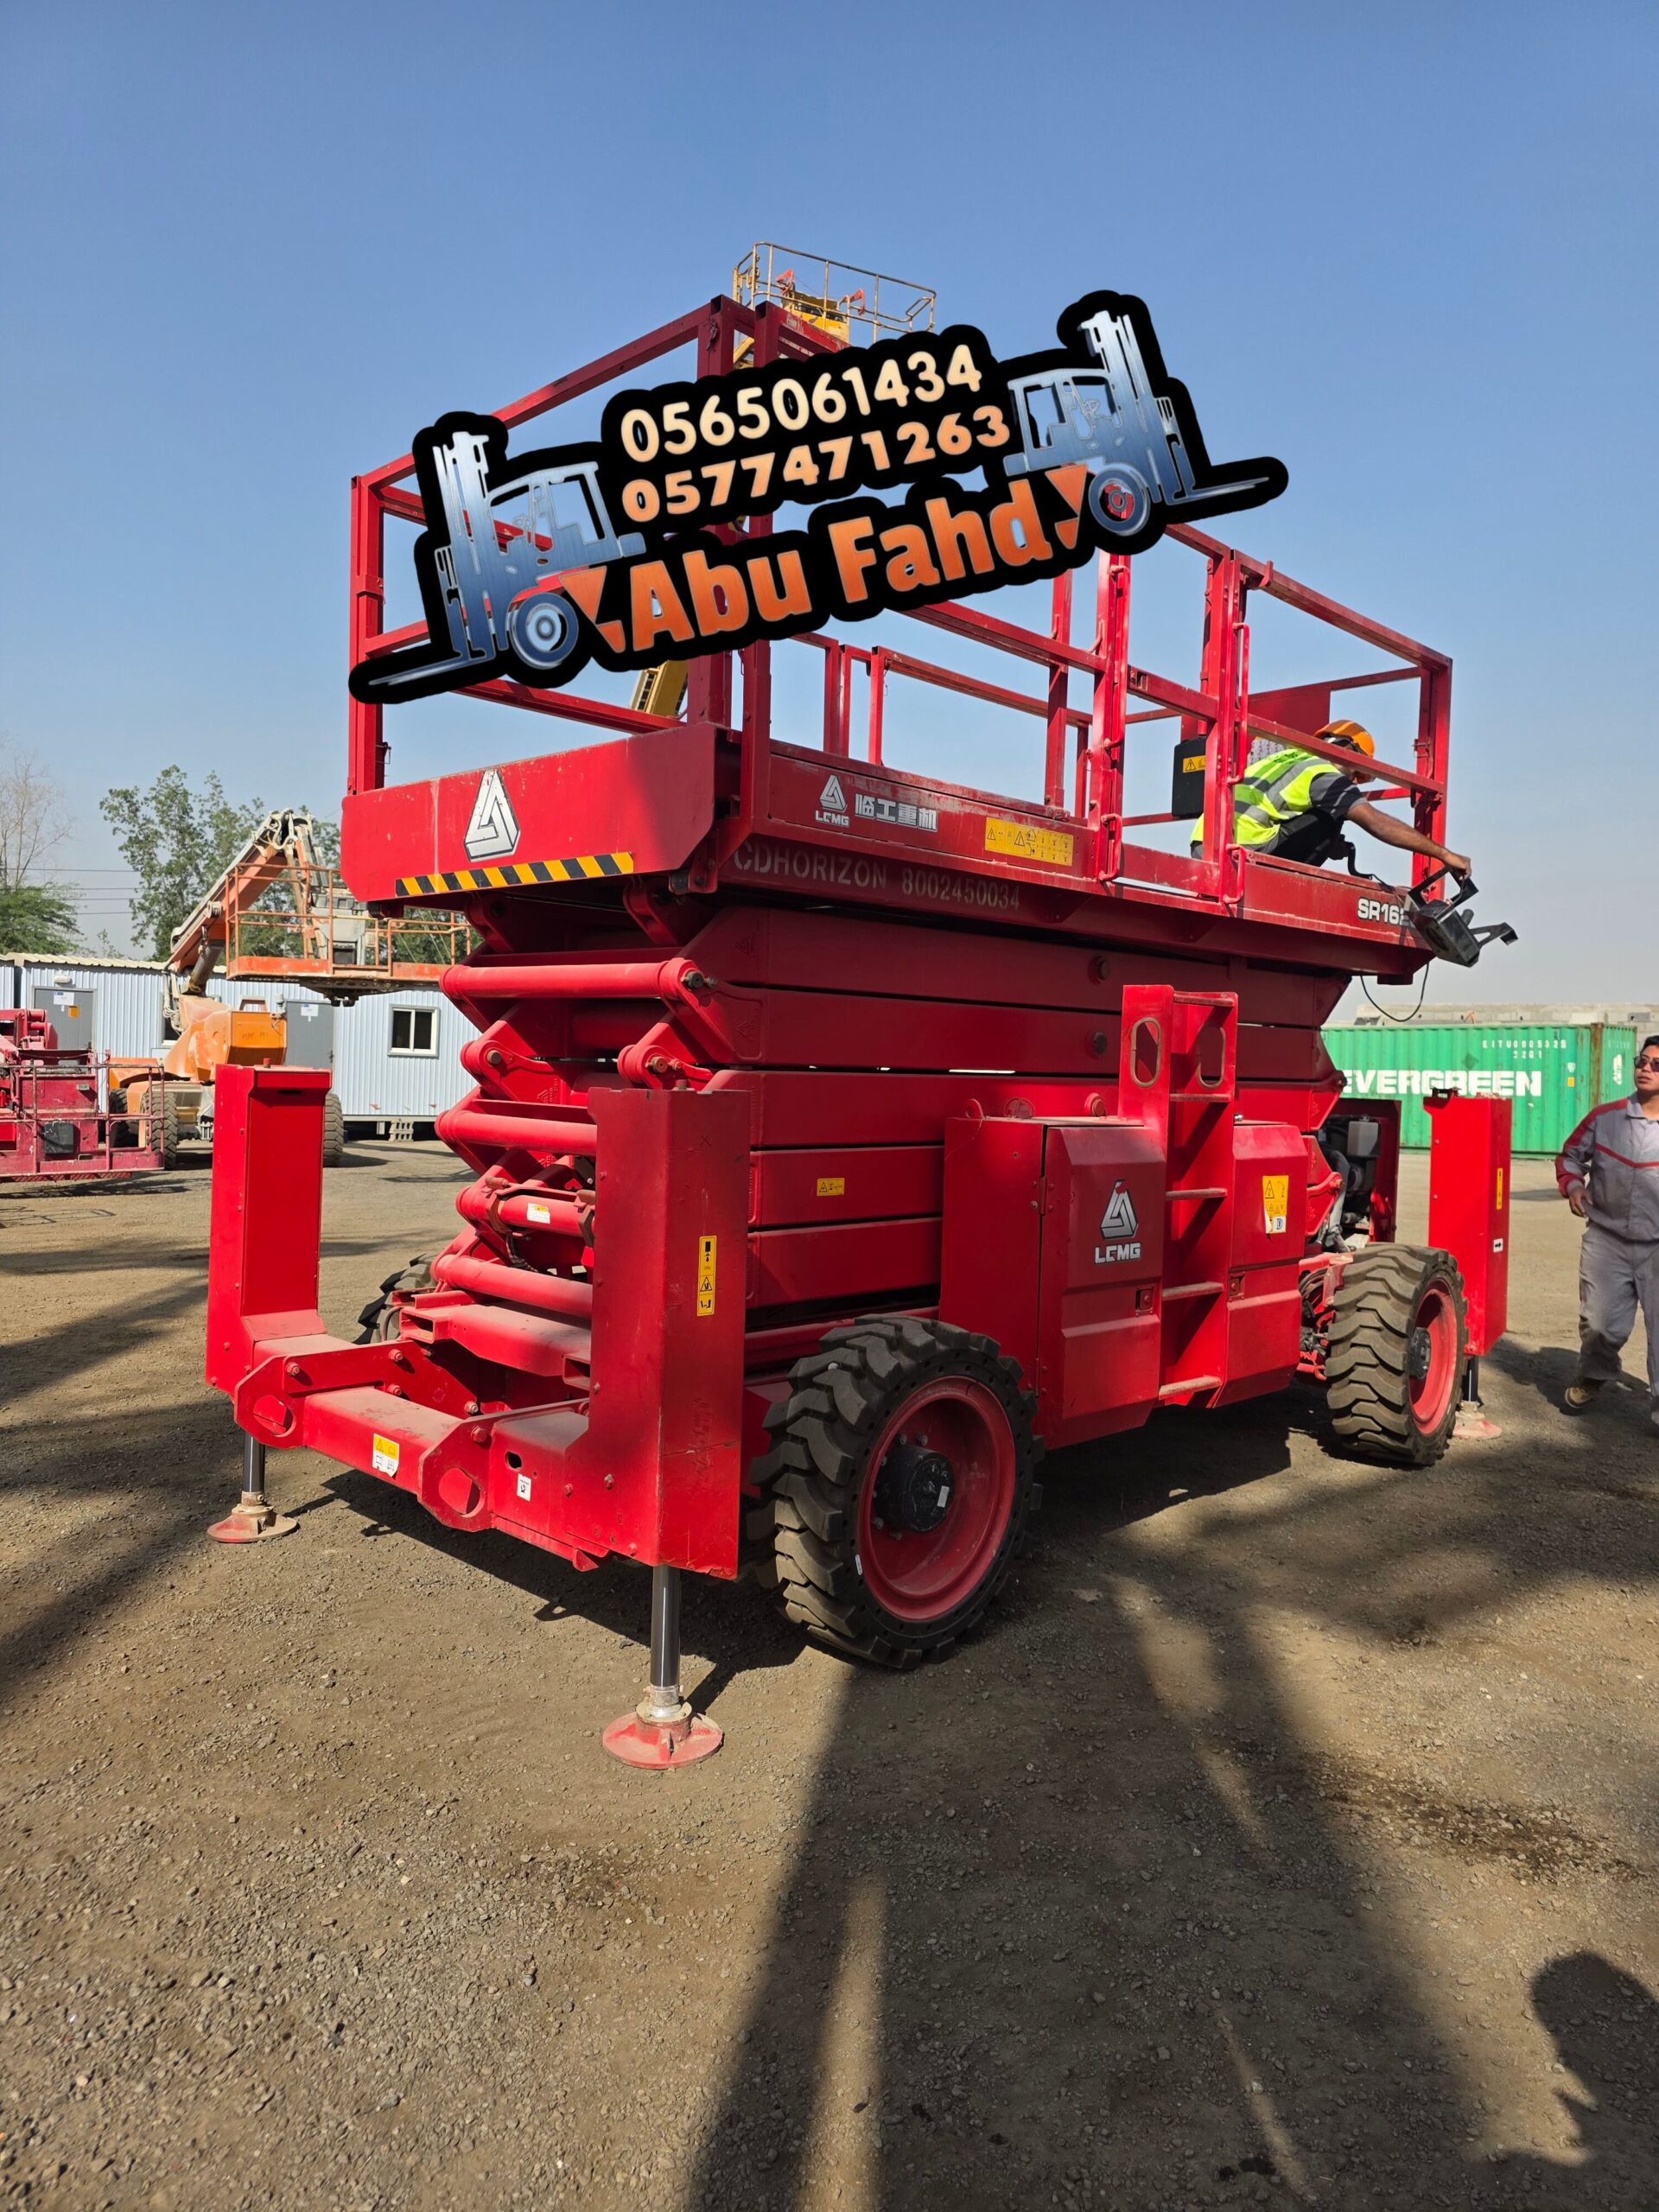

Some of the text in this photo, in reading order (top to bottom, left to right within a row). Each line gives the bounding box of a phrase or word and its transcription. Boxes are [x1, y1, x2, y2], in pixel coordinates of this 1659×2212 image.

[855, 793, 938, 831] 临工重机
[734, 842, 887, 889] CDHORIZON
[902, 872, 1020, 911] 8002450034
[1340, 1070, 1541, 1096] EVERGREEN
